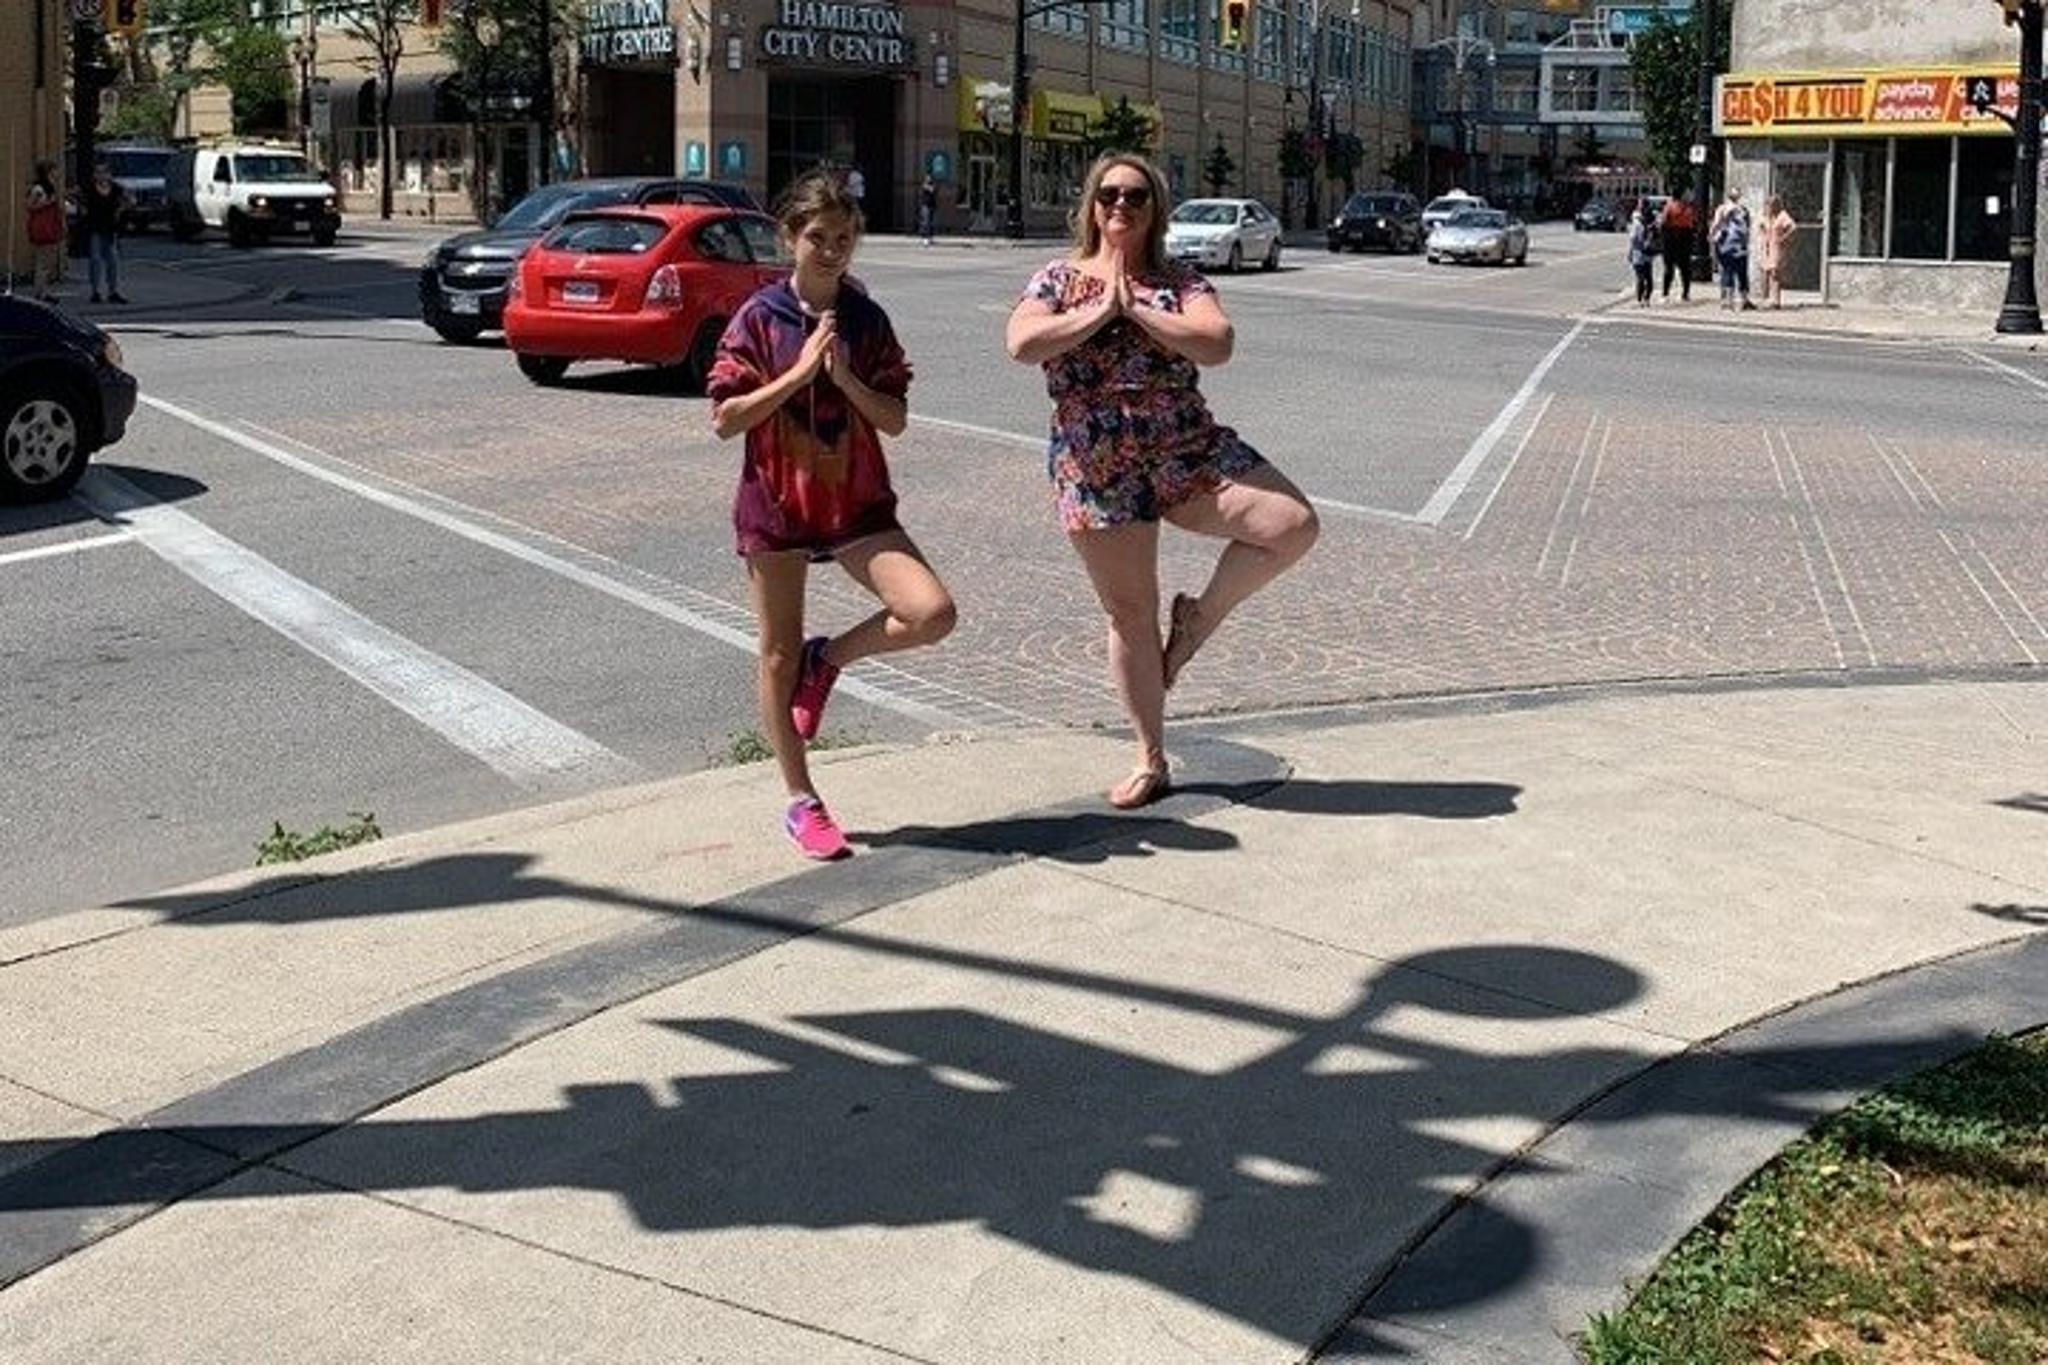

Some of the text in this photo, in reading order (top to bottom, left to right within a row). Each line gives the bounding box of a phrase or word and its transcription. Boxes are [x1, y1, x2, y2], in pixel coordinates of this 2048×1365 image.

[781, 0, 903, 33] HAMILTON
[613, 27, 672, 57] CENTRE
[764, 28, 903, 64] CITY CENTR
[1722, 80, 1864, 127] CA$H 4 YOU
[1878, 79, 1937, 103] payday
[1874, 103, 1942, 120] advance
